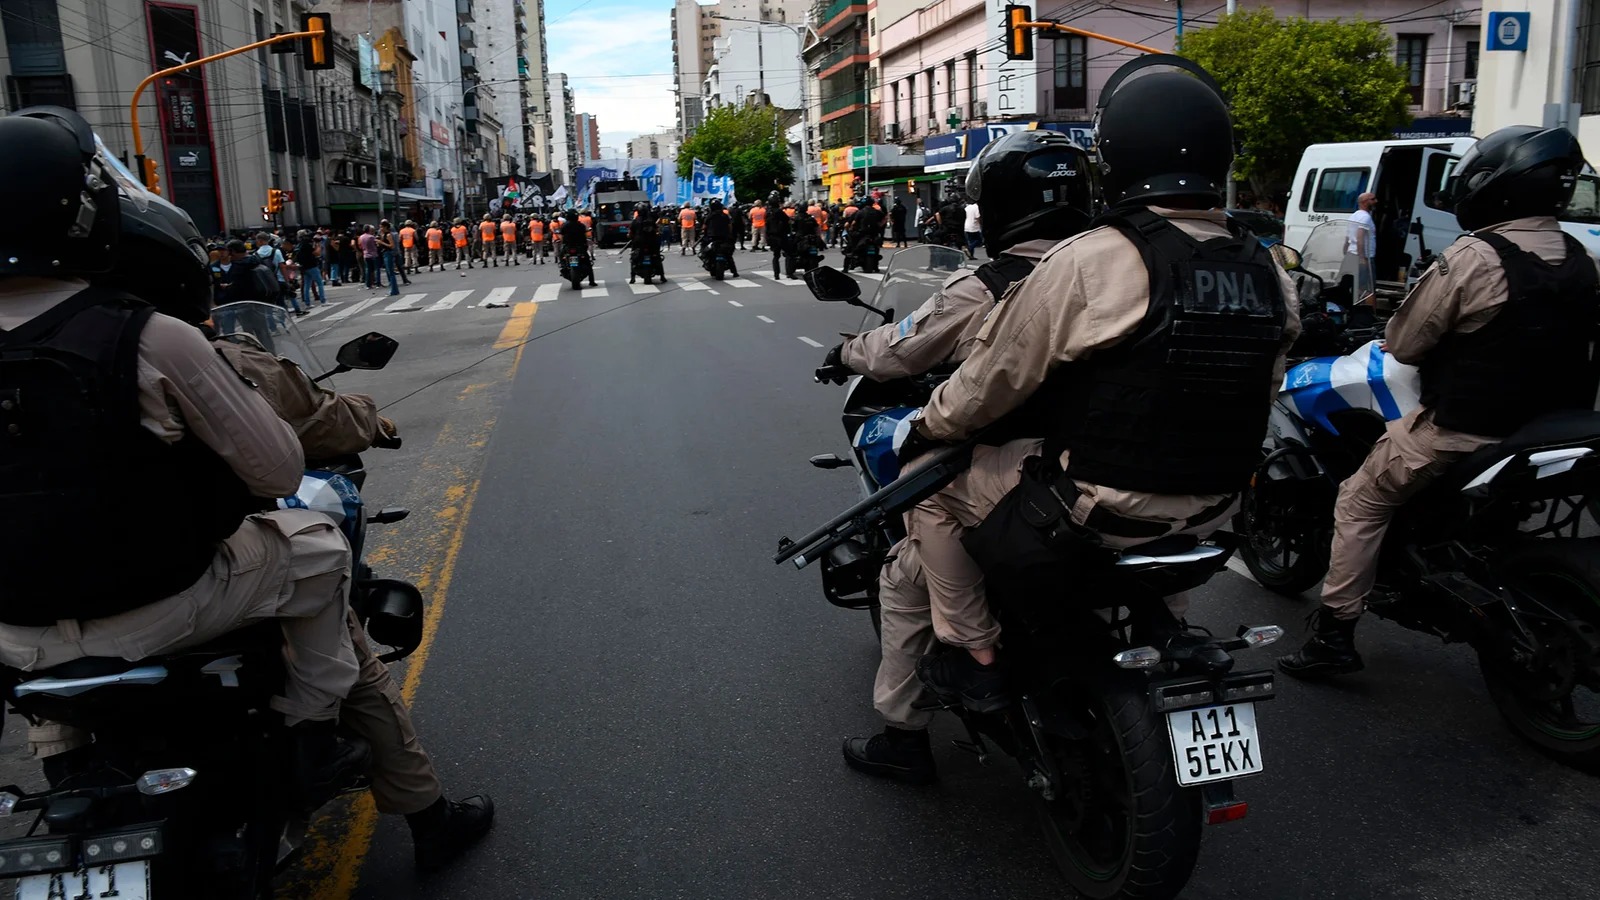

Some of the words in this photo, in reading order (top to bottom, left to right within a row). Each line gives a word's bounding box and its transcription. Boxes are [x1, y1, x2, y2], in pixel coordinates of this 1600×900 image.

[181, 101, 193, 115] 25
[1307, 213, 1329, 222] telefe
[1195, 269, 1260, 310] PNA
[1191, 706, 1240, 742] A11
[1186, 739, 1254, 777] 5EKX
[48, 864, 119, 900] A11
